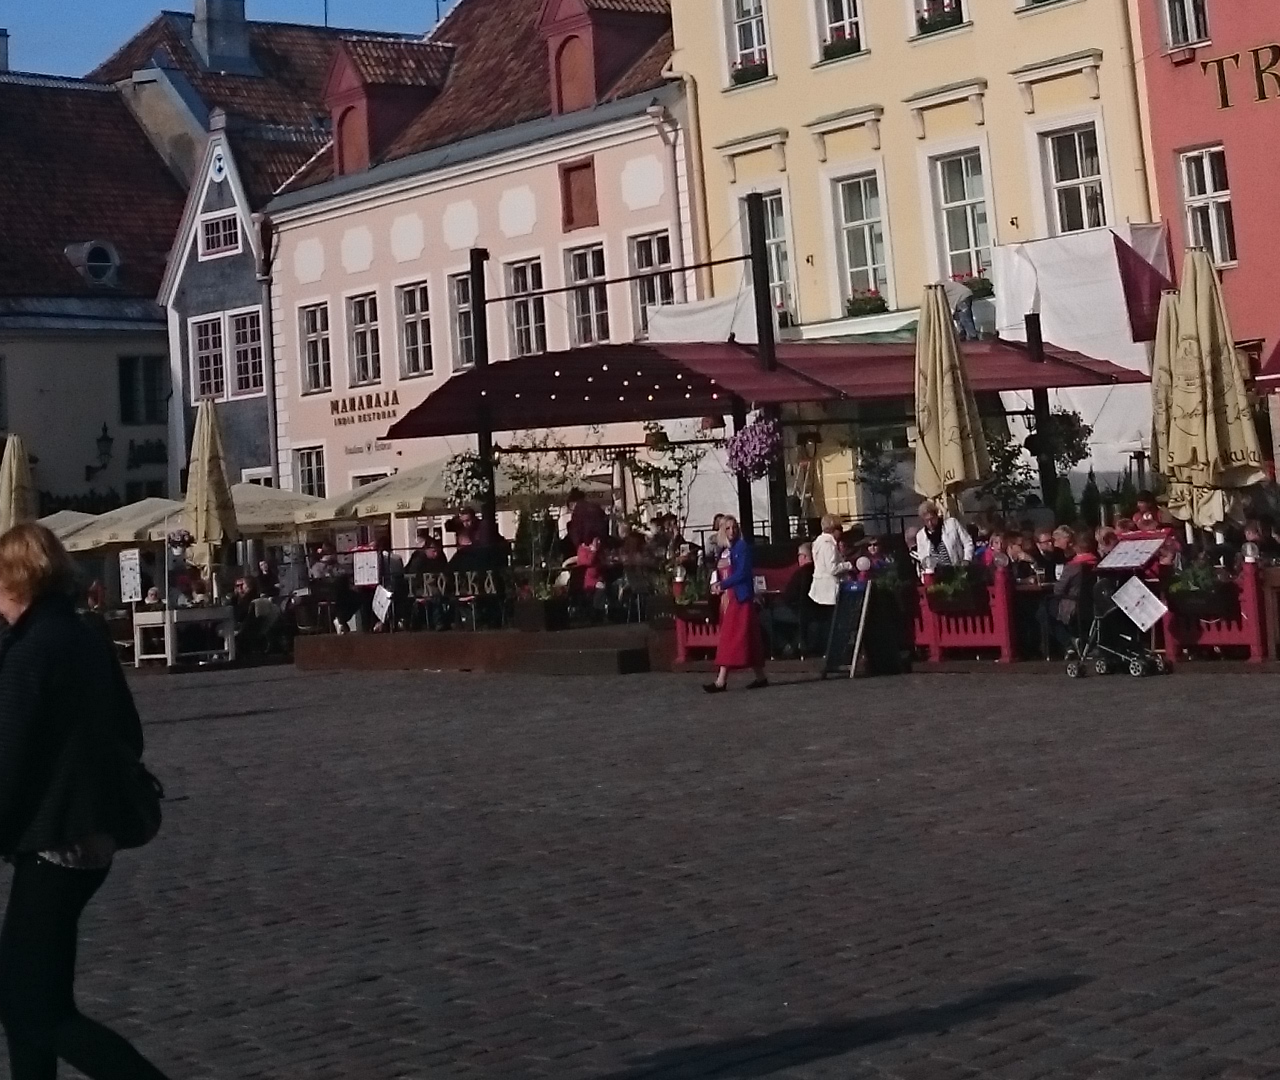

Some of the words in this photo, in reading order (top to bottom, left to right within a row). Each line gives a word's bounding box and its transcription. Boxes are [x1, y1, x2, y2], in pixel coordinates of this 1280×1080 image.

[329, 390, 400, 416] MAHARAJA
[334, 416, 355, 427] INDIA
[358, 409, 398, 423] RESTORAN
[403, 568, 498, 598] TROIKA
